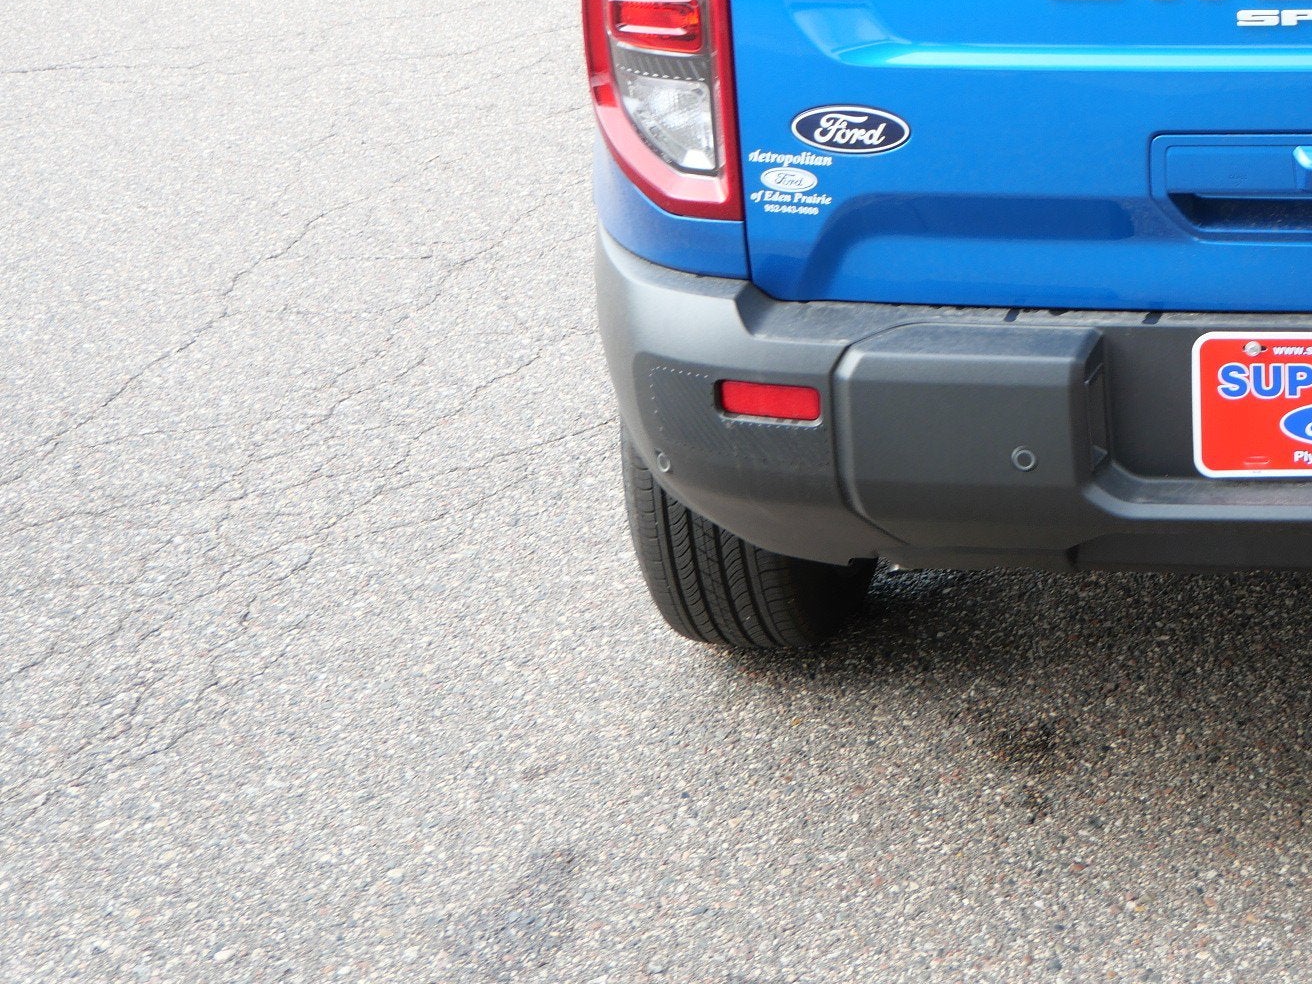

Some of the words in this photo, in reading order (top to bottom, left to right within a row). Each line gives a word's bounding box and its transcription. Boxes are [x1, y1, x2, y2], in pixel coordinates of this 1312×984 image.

[813, 113, 887, 146] Ford
[750, 190, 765, 203] of
[763, 191, 791, 203] Eden
[793, 193, 832, 205] Prairie
